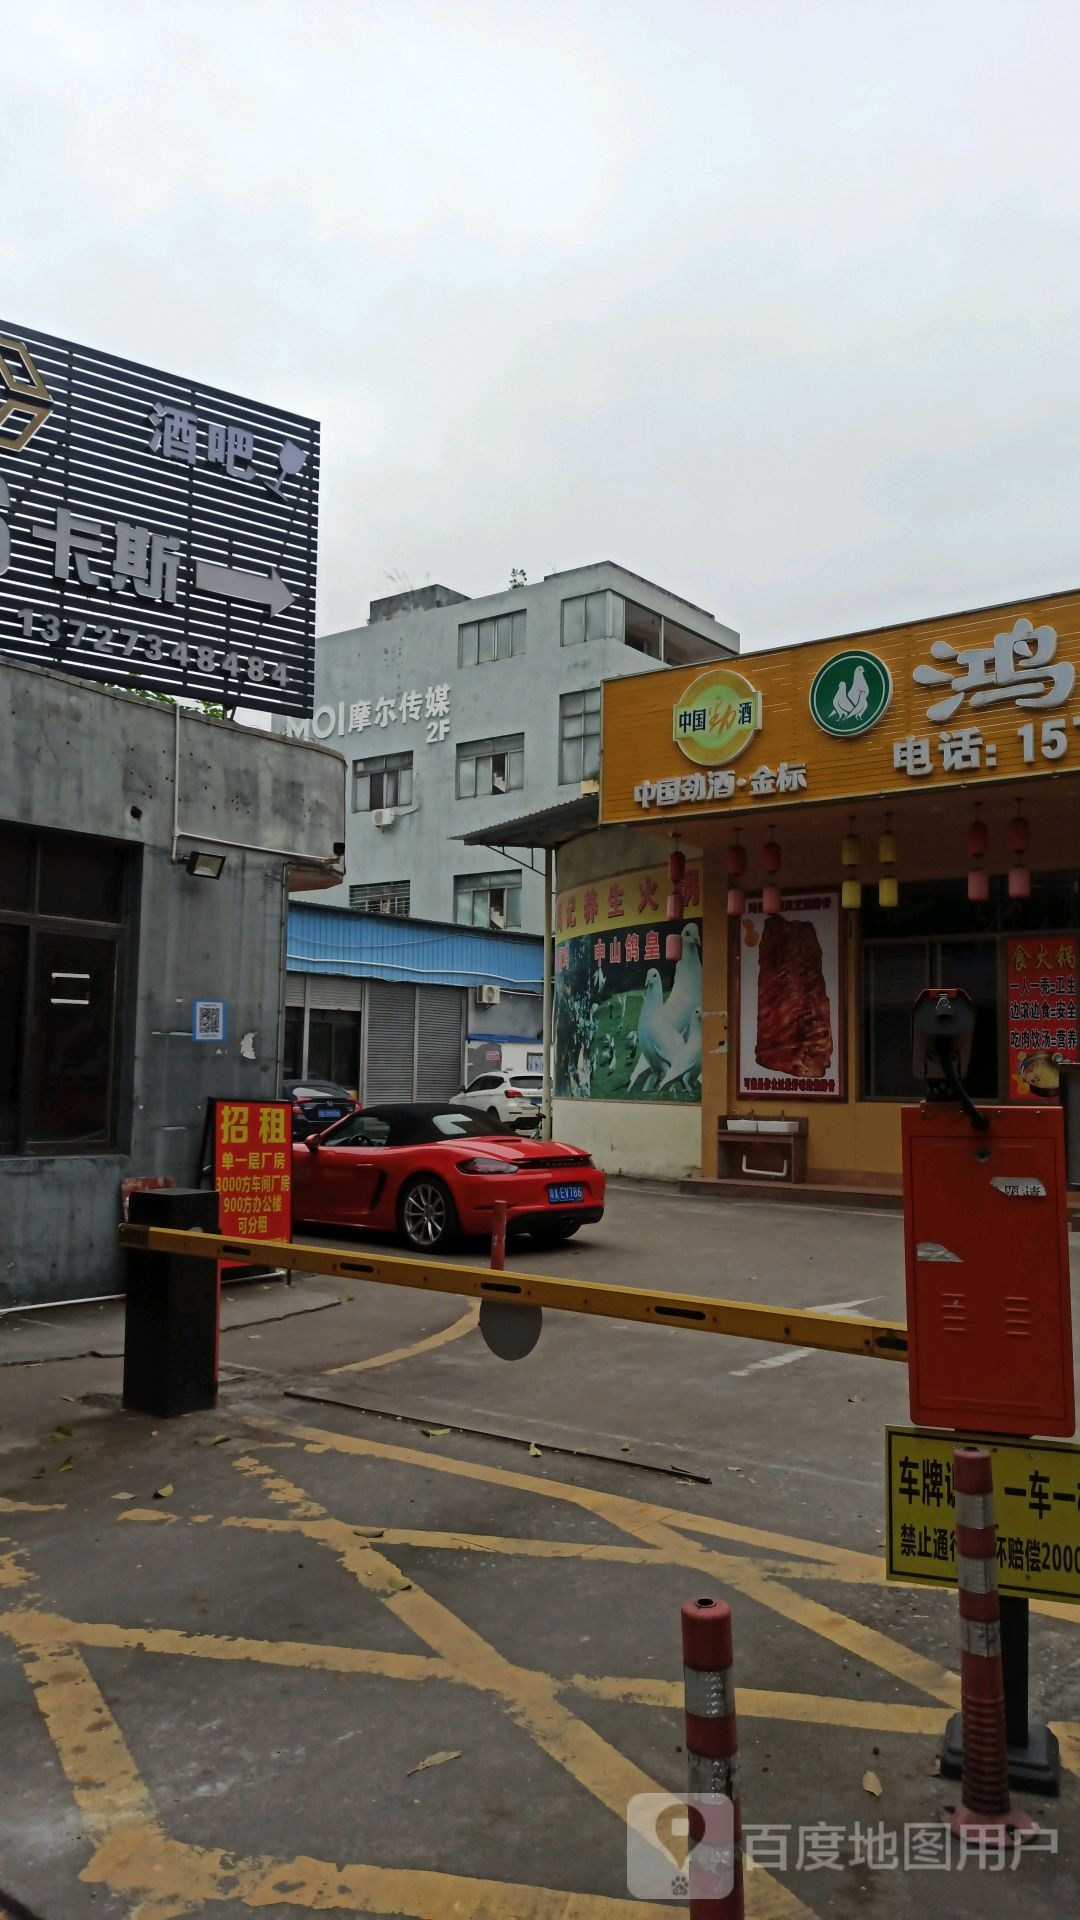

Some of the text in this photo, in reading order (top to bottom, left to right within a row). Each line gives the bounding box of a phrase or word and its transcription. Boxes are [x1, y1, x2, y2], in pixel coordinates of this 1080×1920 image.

[147, 401, 257, 481] 酒吧
[31, 507, 182, 604] 卡斯
[17, 608, 290, 688] 13727348484
[912, 618, 1076, 722] 鸿
[426, 721, 451, 745] 2F
[1017, 716, 1080, 764] 15
[633, 763, 807, 809] 中国劲酒·金标
[594, 931, 661, 968] 中山鸽皇
[1010, 1028, 1077, 1049] 吃肉饮汤=营养
[220, 1105, 287, 1144] 招租
[221, 1152, 286, 1171] 单一层厂房
[215, 1175, 291, 1194] 3000方车间厂房
[224, 1195, 282, 1214] 900方办公楼
[237, 1216, 268, 1235] 可分租
[1004, 1470, 1080, 1520] 一车一
